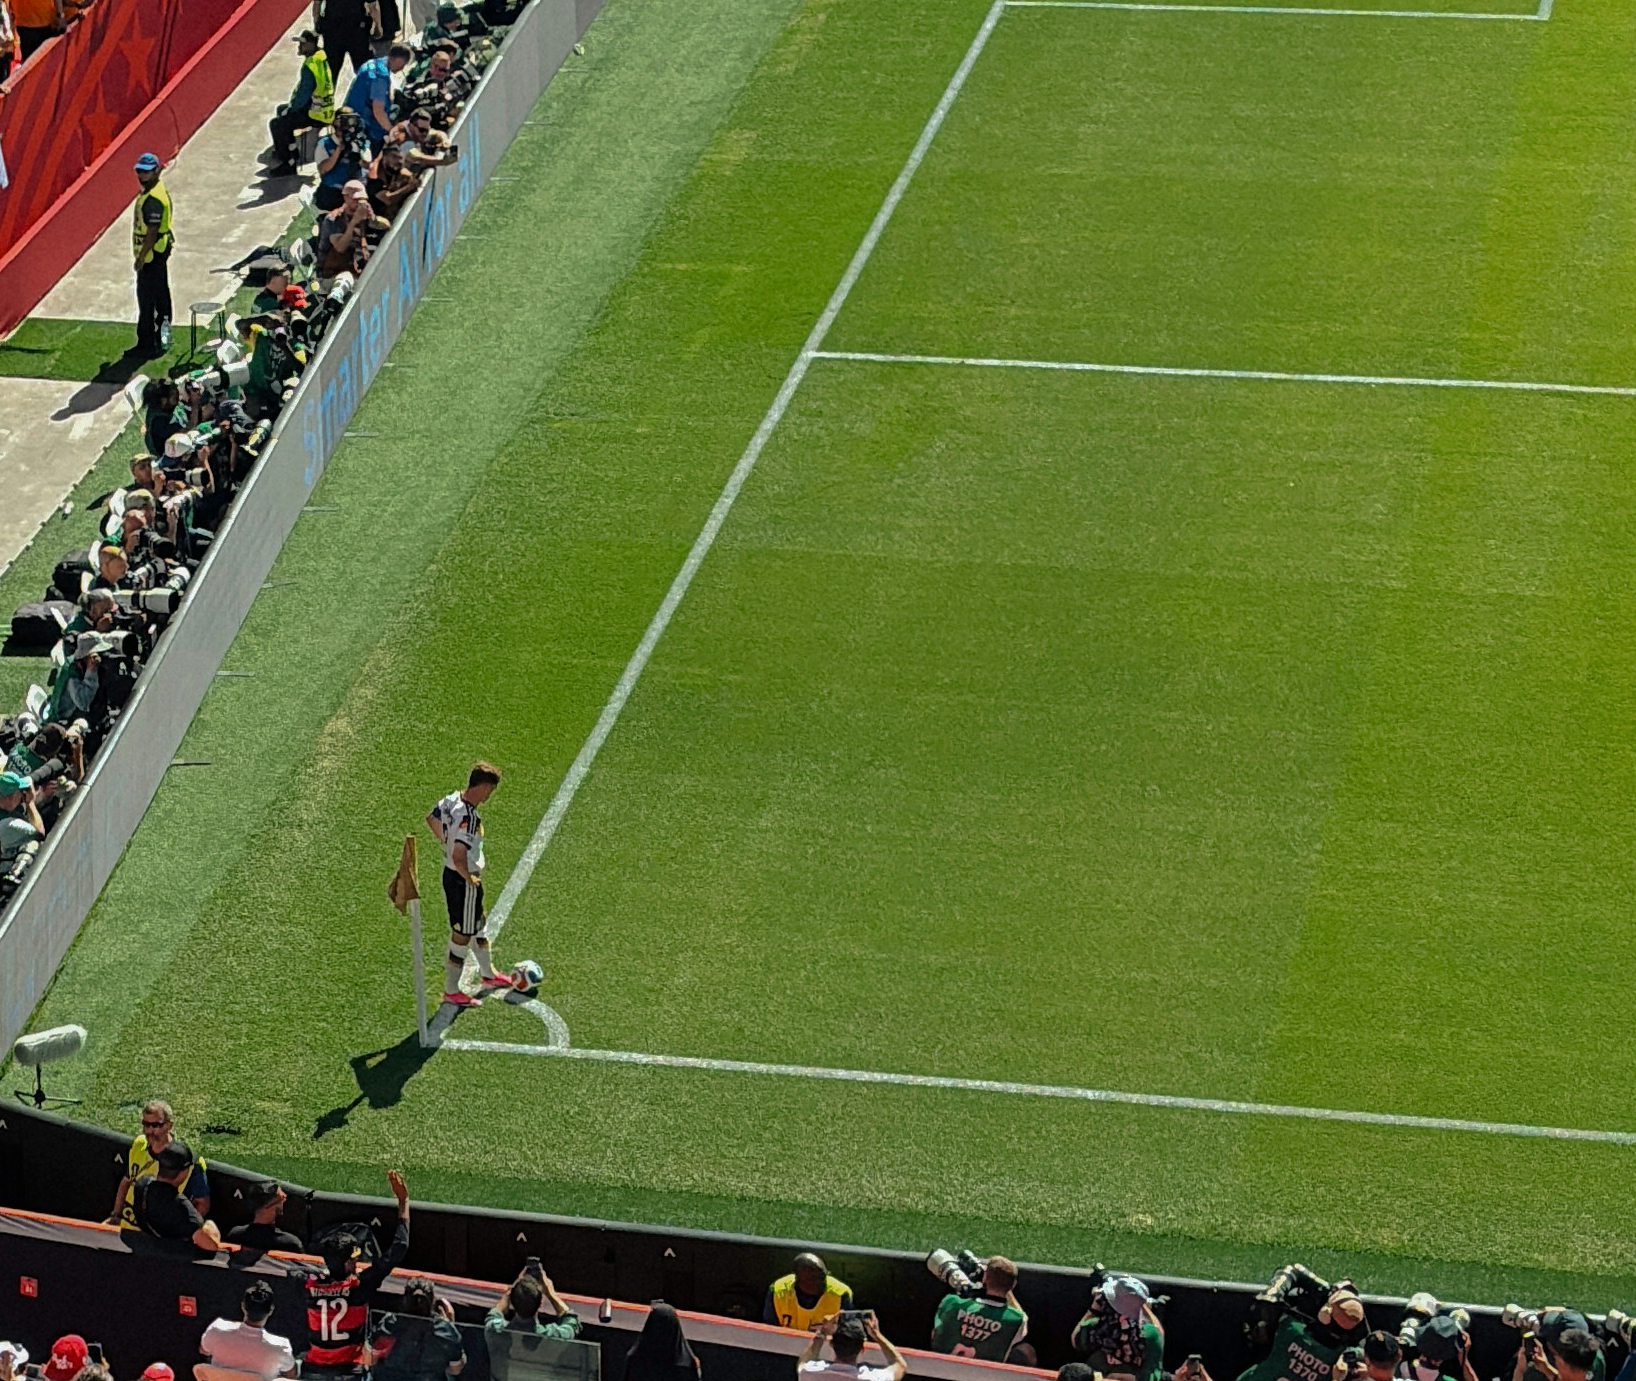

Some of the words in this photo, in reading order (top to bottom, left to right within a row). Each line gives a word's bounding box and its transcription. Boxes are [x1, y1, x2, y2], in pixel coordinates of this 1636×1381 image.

[459, 110, 480, 214] all
[317, 1298, 350, 1342] 12
[956, 1309, 1002, 1333] PHOTO
[960, 1324, 992, 1341] 1377
[1287, 1342, 1331, 1375] PHOTO
